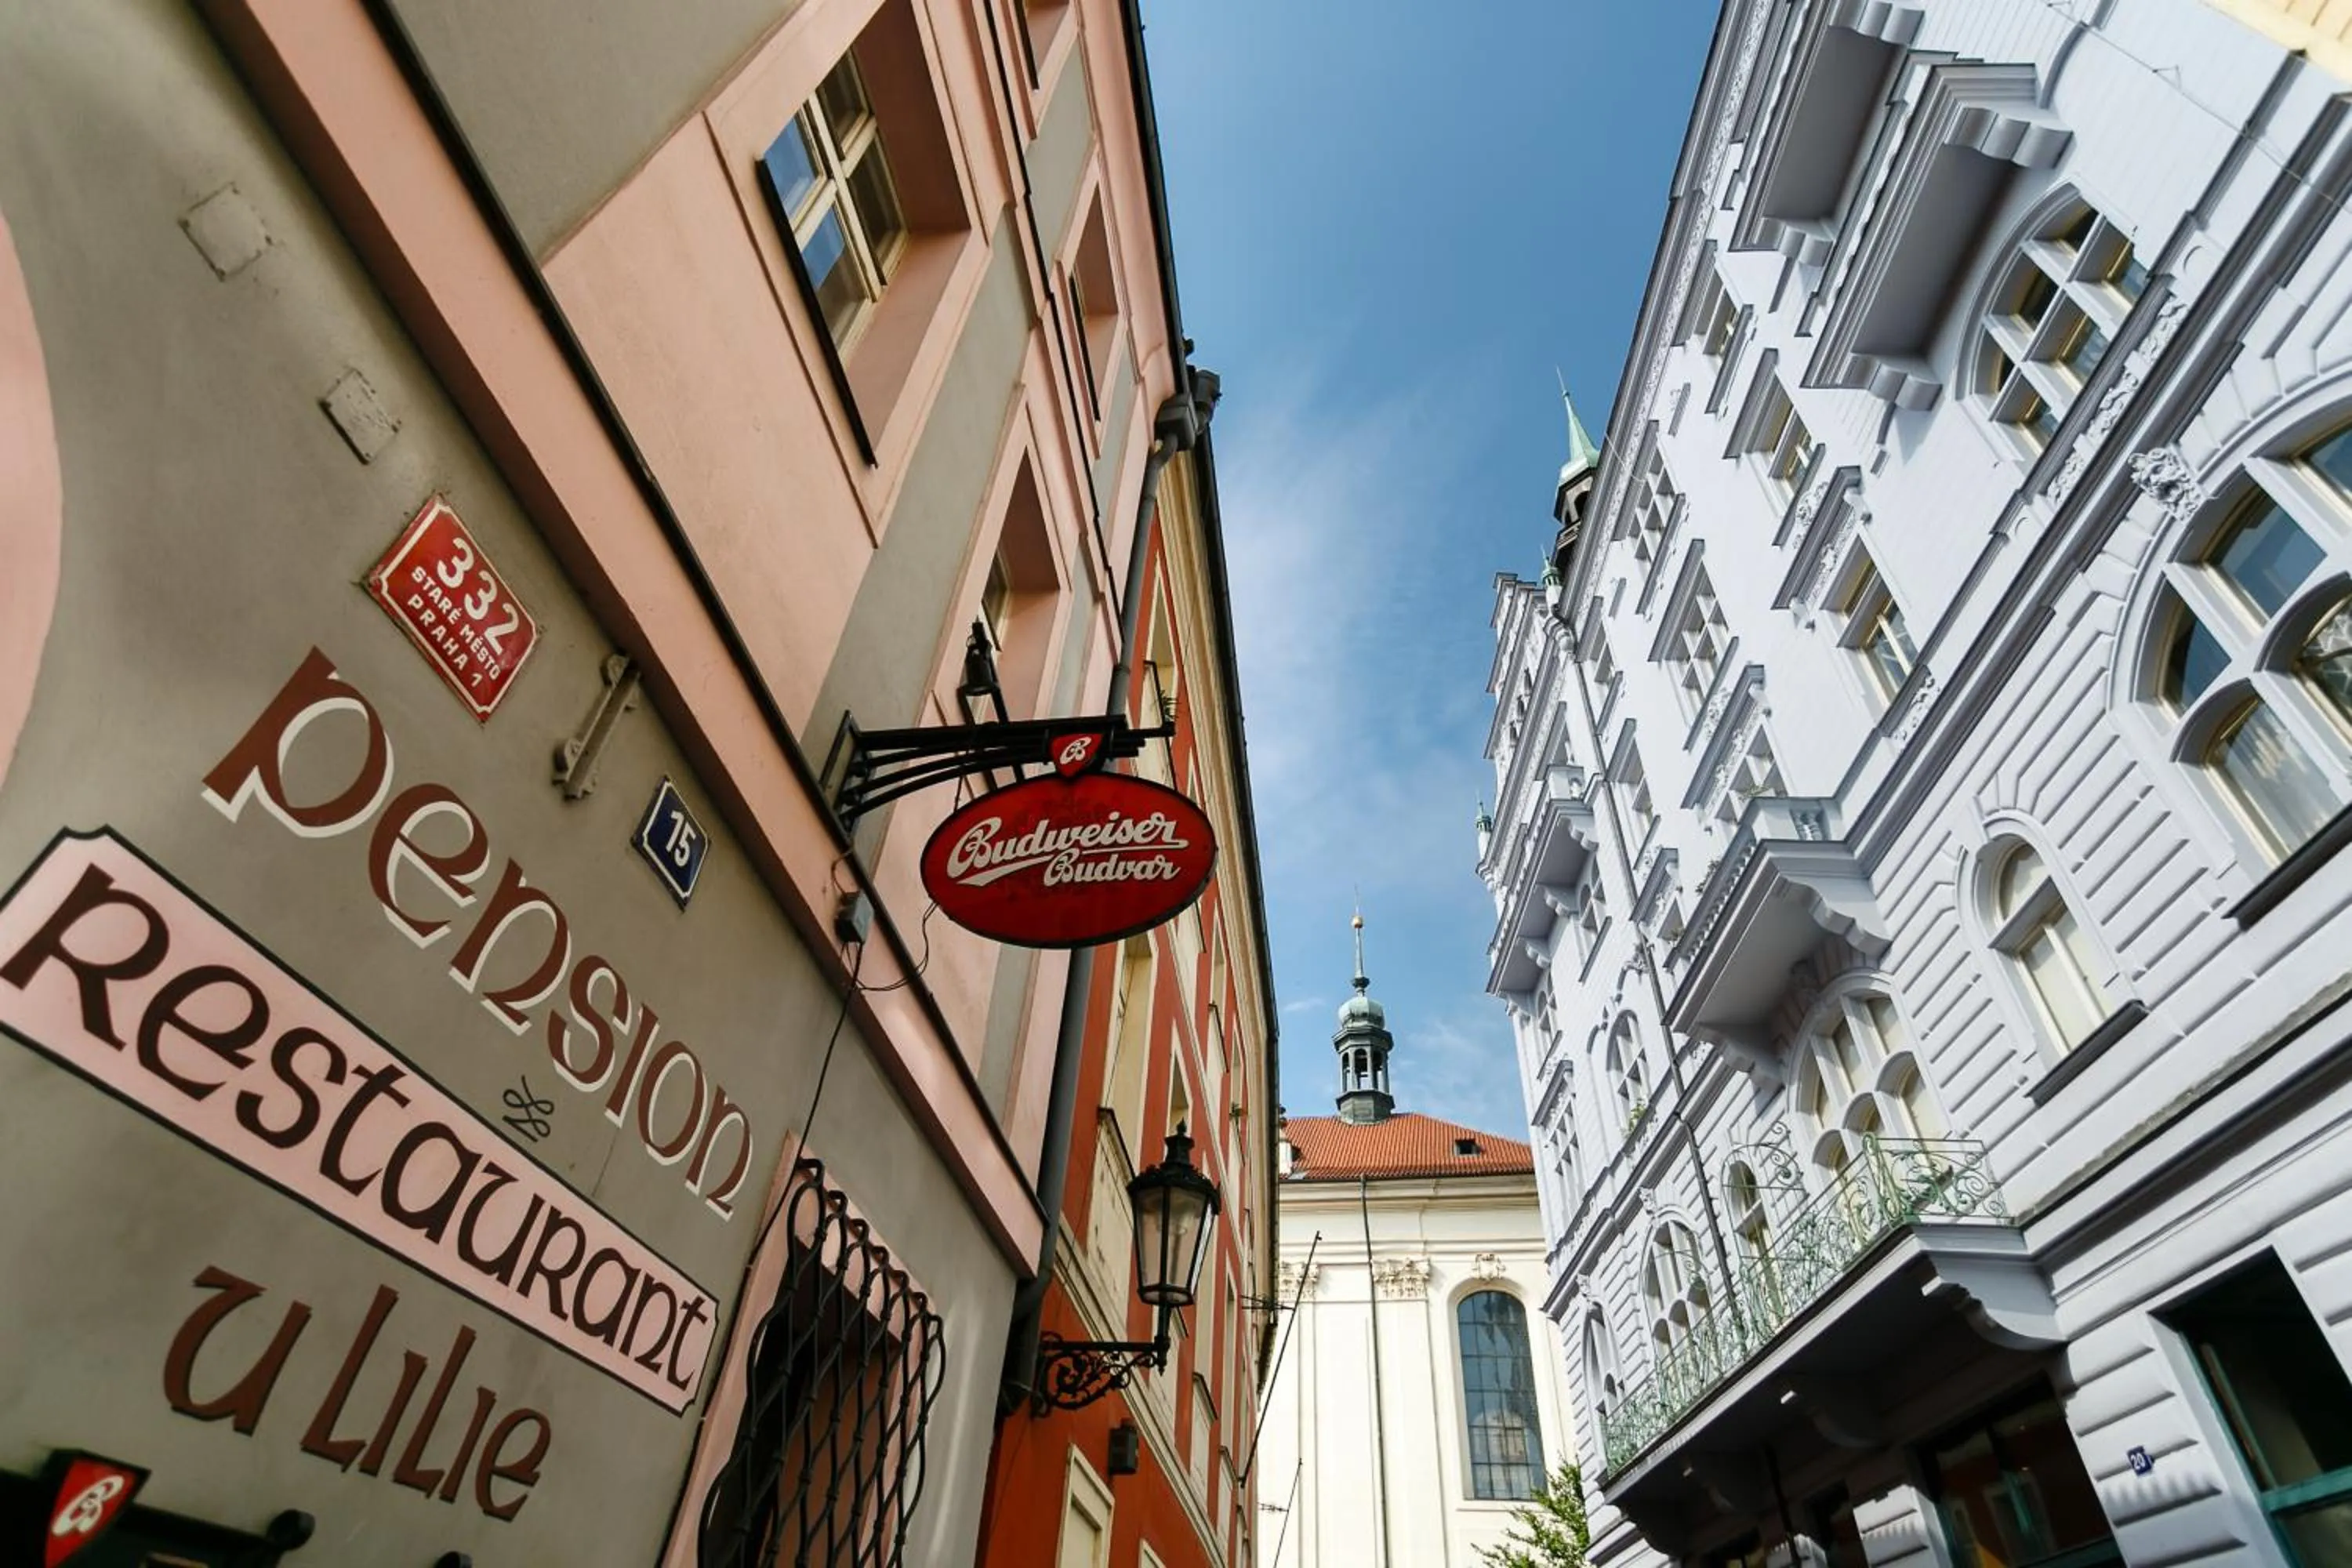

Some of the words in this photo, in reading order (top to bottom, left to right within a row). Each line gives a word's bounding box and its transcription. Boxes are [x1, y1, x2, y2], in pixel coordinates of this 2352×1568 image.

[411, 566, 463, 625] STARÉ
[437, 537, 519, 655] 332
[407, 593, 469, 671] PRAHA
[471, 673, 483, 688] 1
[665, 811, 697, 867] 15
[946, 811, 1189, 880] Budweiser
[1044, 848, 1181, 887] Budvar
[2130, 1453, 2146, 1470] 20
